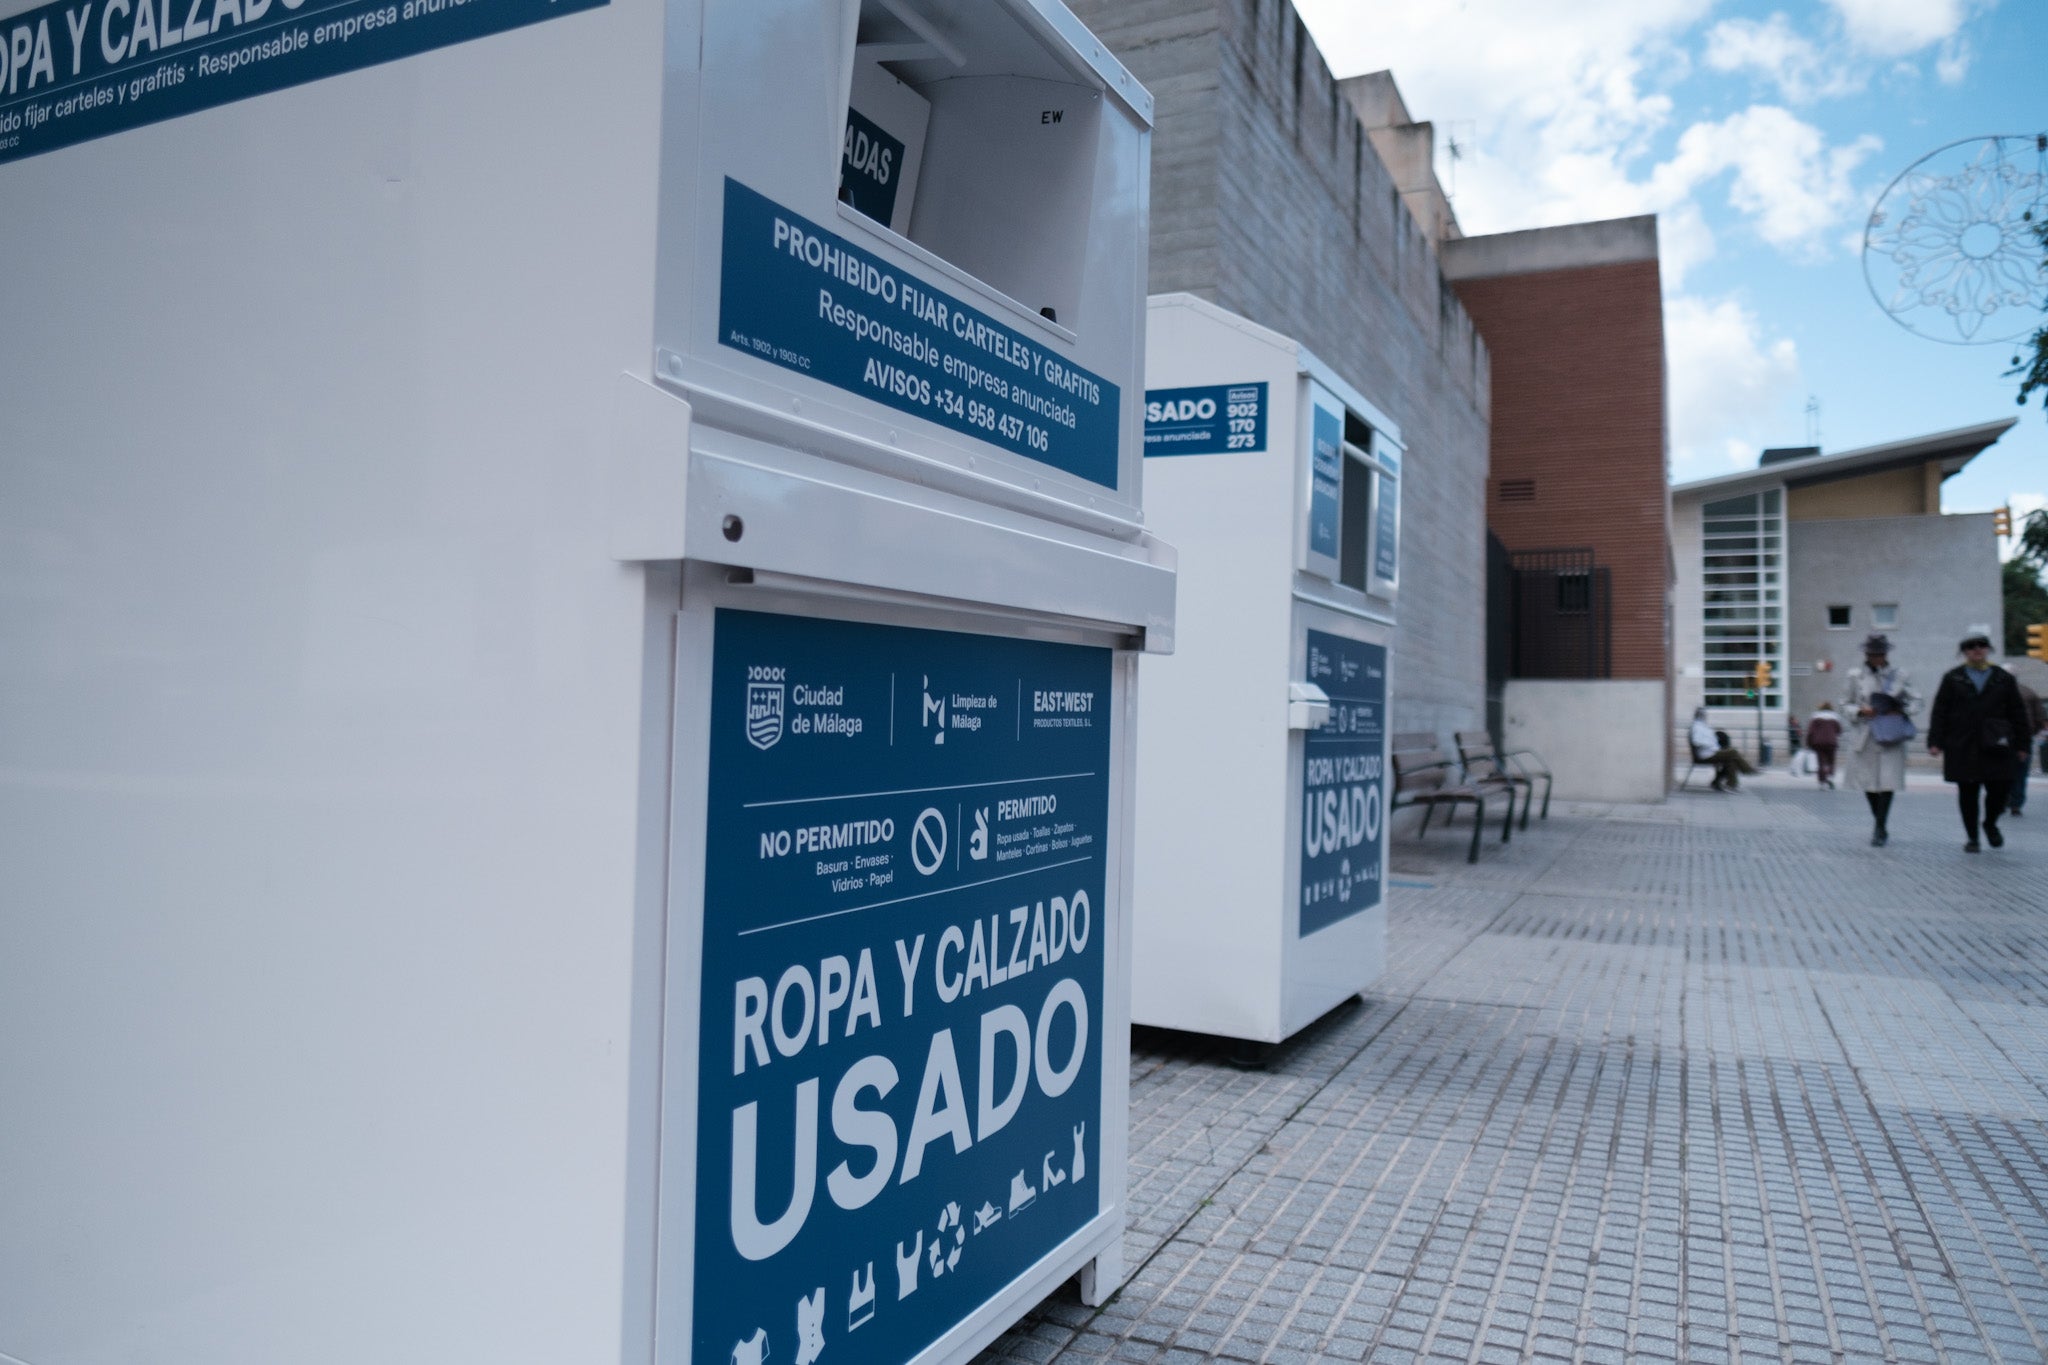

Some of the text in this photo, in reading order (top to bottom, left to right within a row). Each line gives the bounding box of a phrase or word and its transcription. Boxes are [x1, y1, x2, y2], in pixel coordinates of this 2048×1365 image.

[66, 2, 92, 76] Y
[25, 103, 52, 130] fijar
[55, 86, 114, 118] carteles
[118, 83, 127, 105] y
[130, 62, 186, 101] grafitis
[199, 28, 309, 78] Responsable
[313, 8, 397, 45] empresa
[1041, 110, 1064, 125] EW
[9, 136, 20, 148] CC
[844, 124, 893, 186] ADAS
[774, 217, 1100, 405] PROHIBIDO FIJAR CARTELES Y GRAFITIS
[730, 330, 811, 369] Arts. 1902 y 1903 CC
[819, 289, 1076, 429] Responsable empresa anunciada
[864, 358, 1048, 451] AVISOS +34 958 437 106
[1144, 398, 1217, 422] SADO
[1227, 403, 1258, 418] 902
[1228, 419, 1255, 433] 170
[1227, 434, 1256, 449] 273
[793, 684, 843, 706] Ciudad
[952, 694, 997, 711] Limpieza de
[792, 713, 862, 737] de Málaga
[952, 714, 982, 731] Málaga
[1033, 718, 1062, 728] PRODUCTOS
[1308, 755, 1381, 787] ROPA Y CALZADO
[997, 794, 1057, 821] PERMITIDO
[1306, 784, 1380, 858] USADO
[760, 818, 895, 859] NO PERMITIDO
[996, 822, 1074, 846] Ropa usada Toallas Zapatos
[996, 834, 1093, 862] Manteles Cortinas Bolsos Juguetes
[816, 854, 889, 876] Basura Envases
[832, 870, 893, 893] Vidrios Papel
[733, 889, 1091, 1076] ROPA Y CALZADO
[731, 978, 1089, 1261] USADO
